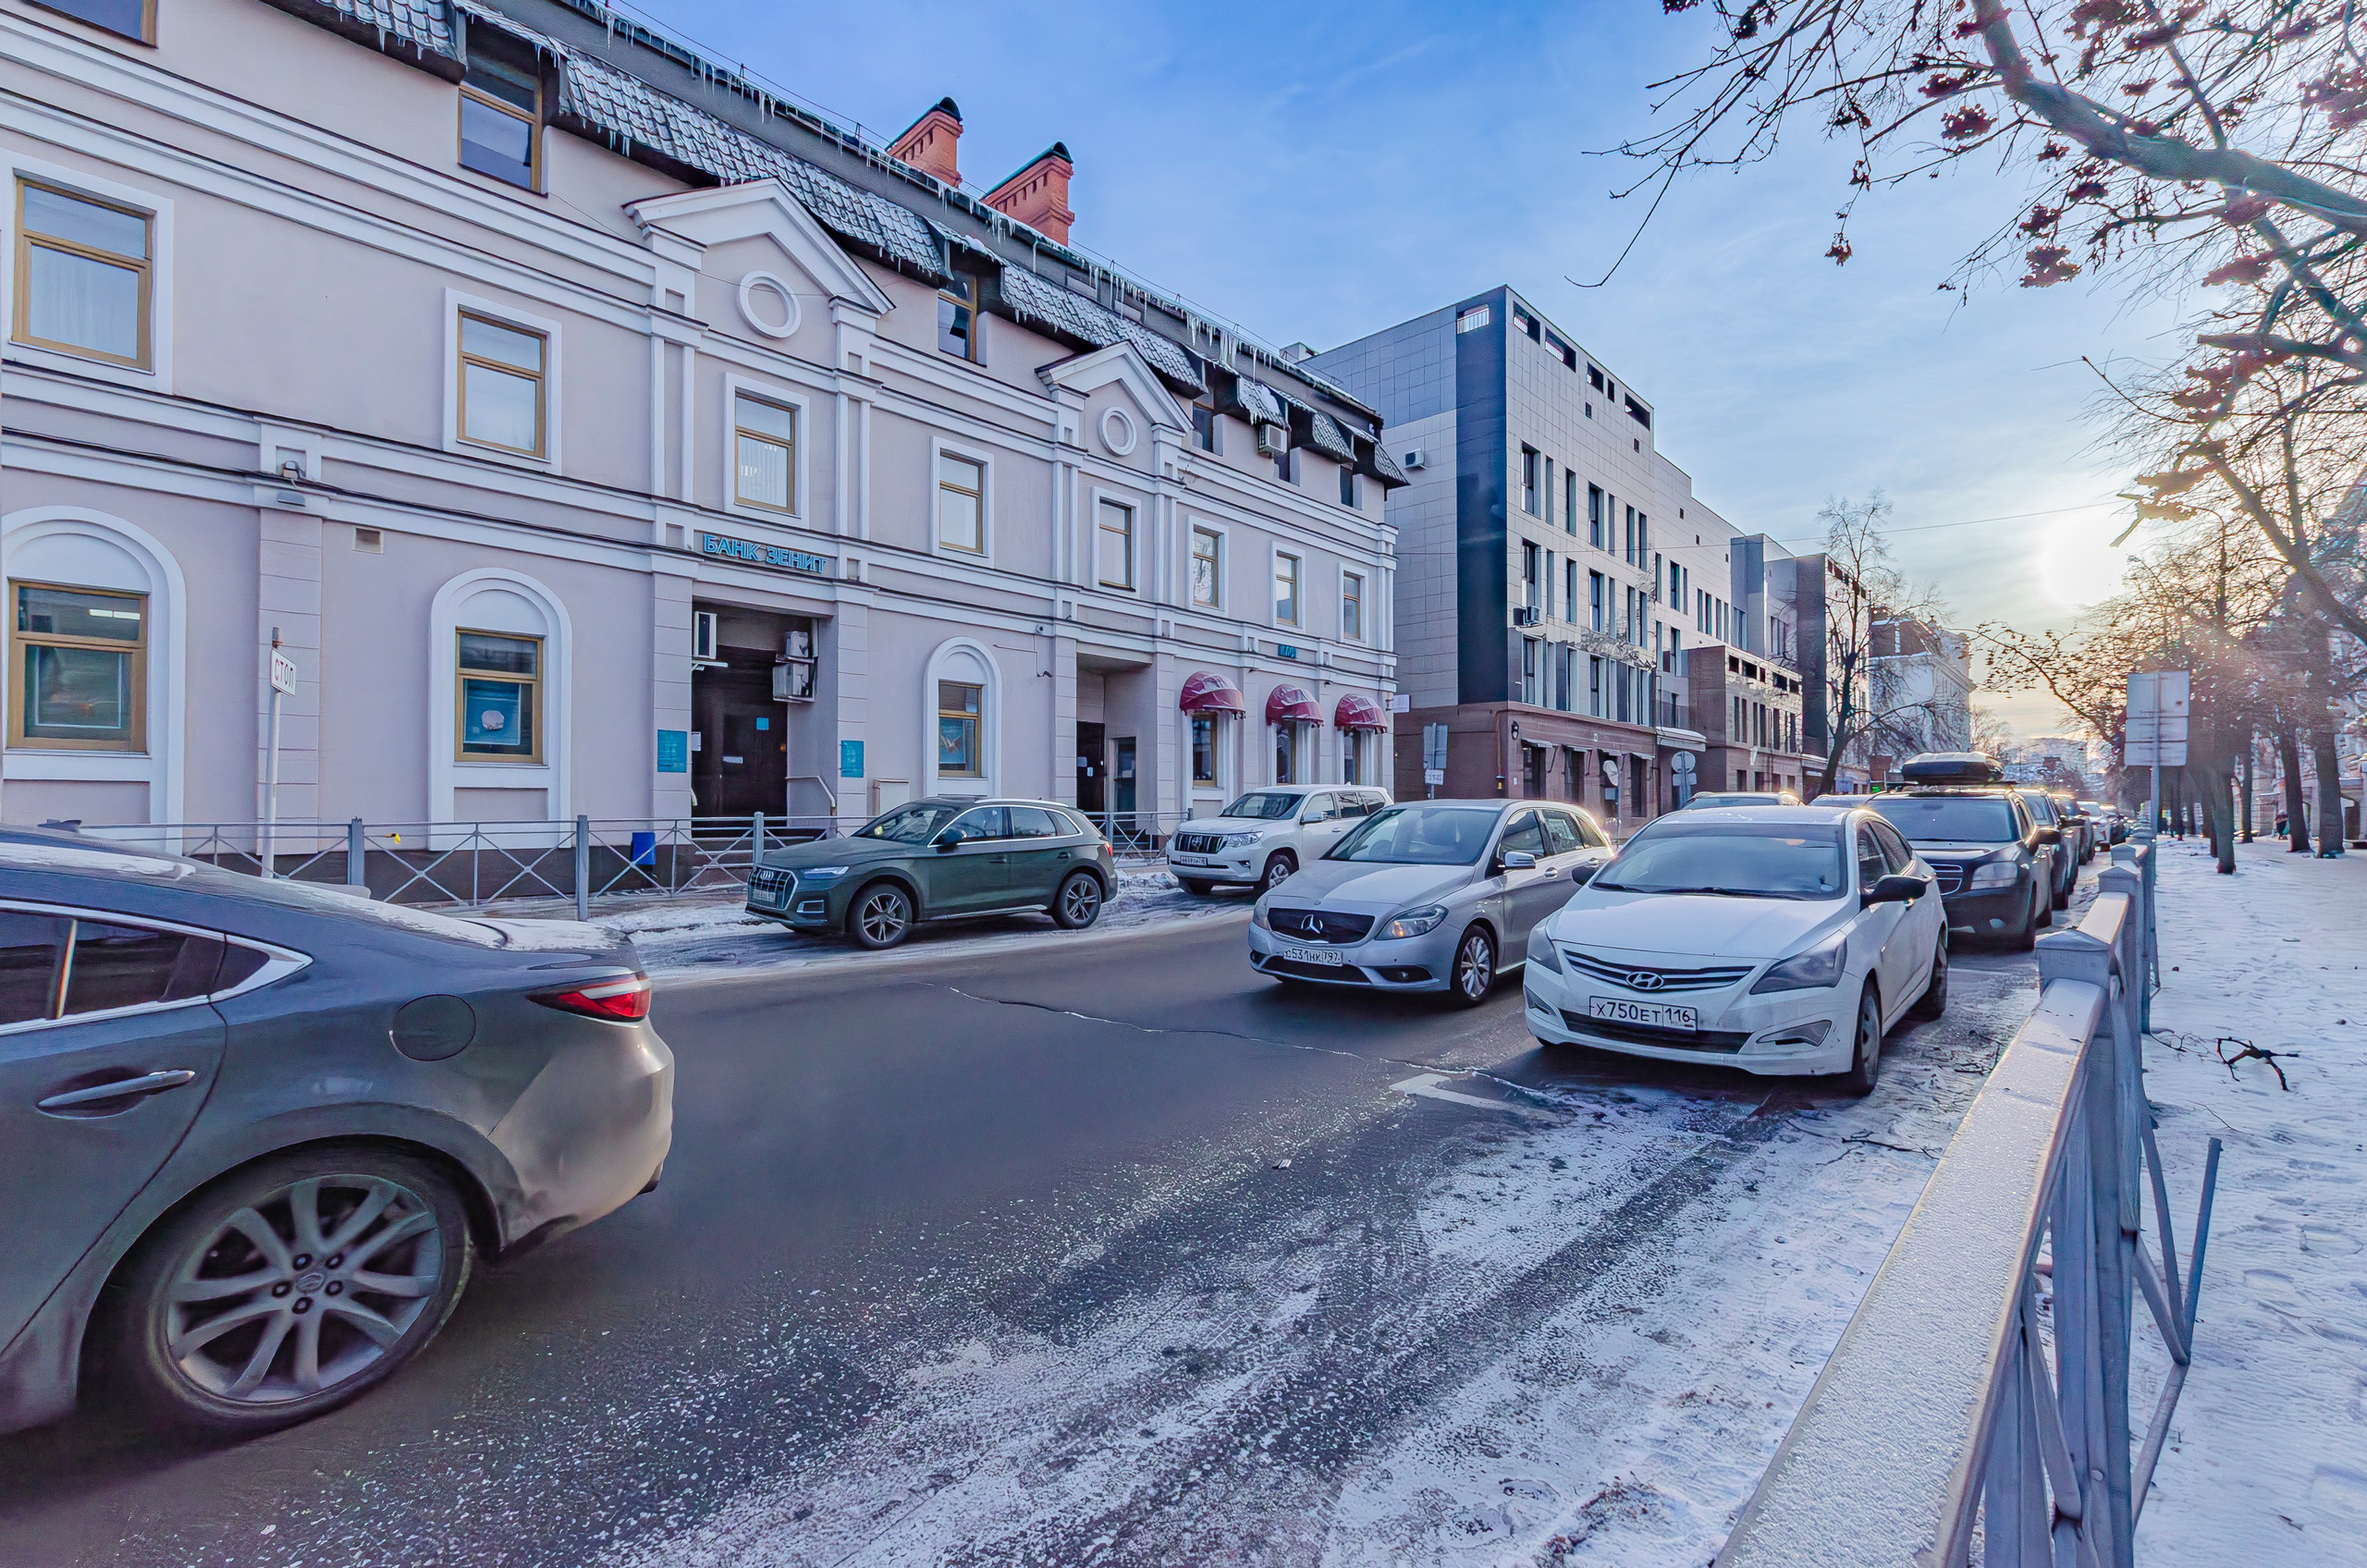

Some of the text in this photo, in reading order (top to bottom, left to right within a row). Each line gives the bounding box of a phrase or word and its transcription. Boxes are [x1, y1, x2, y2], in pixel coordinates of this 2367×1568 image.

[704, 533, 828, 573] БАНК ЗЕНИТ
[275, 658, 294, 688] СТОП
[1596, 1001, 1691, 1023] Х750ЕТ 116
